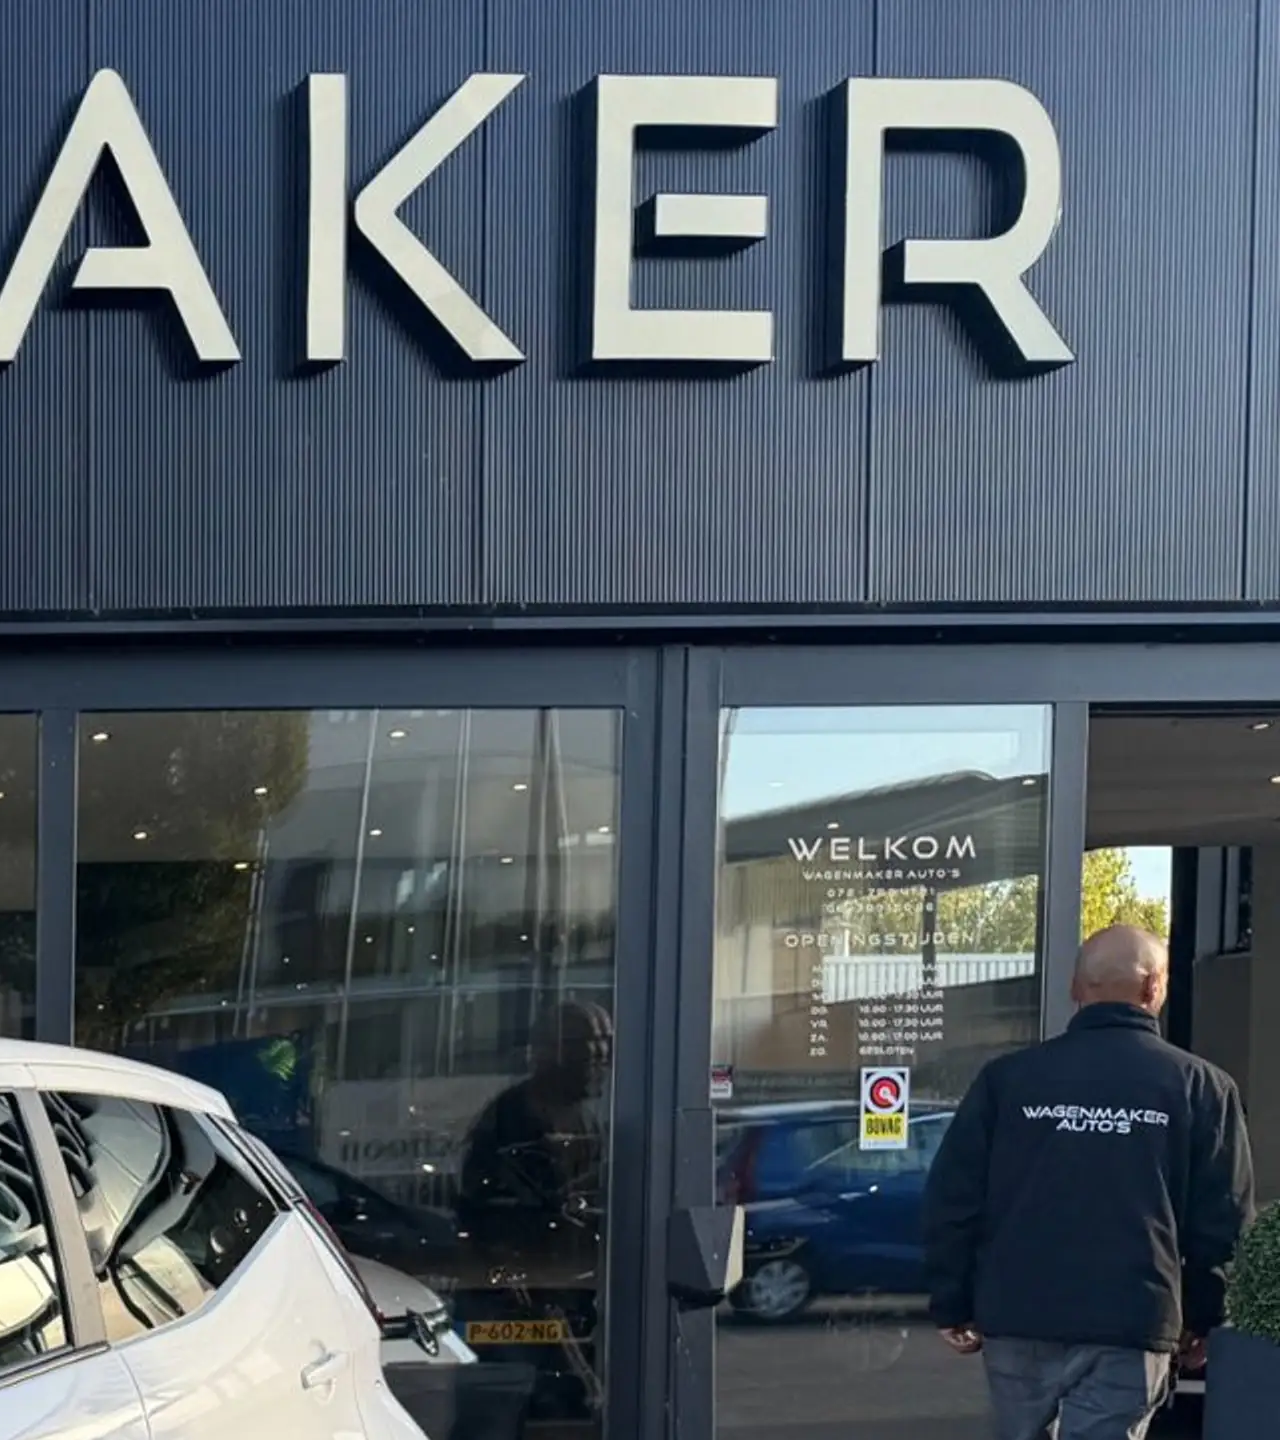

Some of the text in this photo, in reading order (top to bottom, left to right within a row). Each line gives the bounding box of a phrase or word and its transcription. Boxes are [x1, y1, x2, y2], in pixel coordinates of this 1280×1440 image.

[788, 835, 977, 861] WELKOM
[802, 867, 962, 881] WAGENMAKER AUTO'S
[784, 931, 975, 948] OPENNGSTIJDEN
[1022, 1104, 1170, 1126] WAGENMAKER
[1056, 1118, 1131, 1134] AUTO'S
